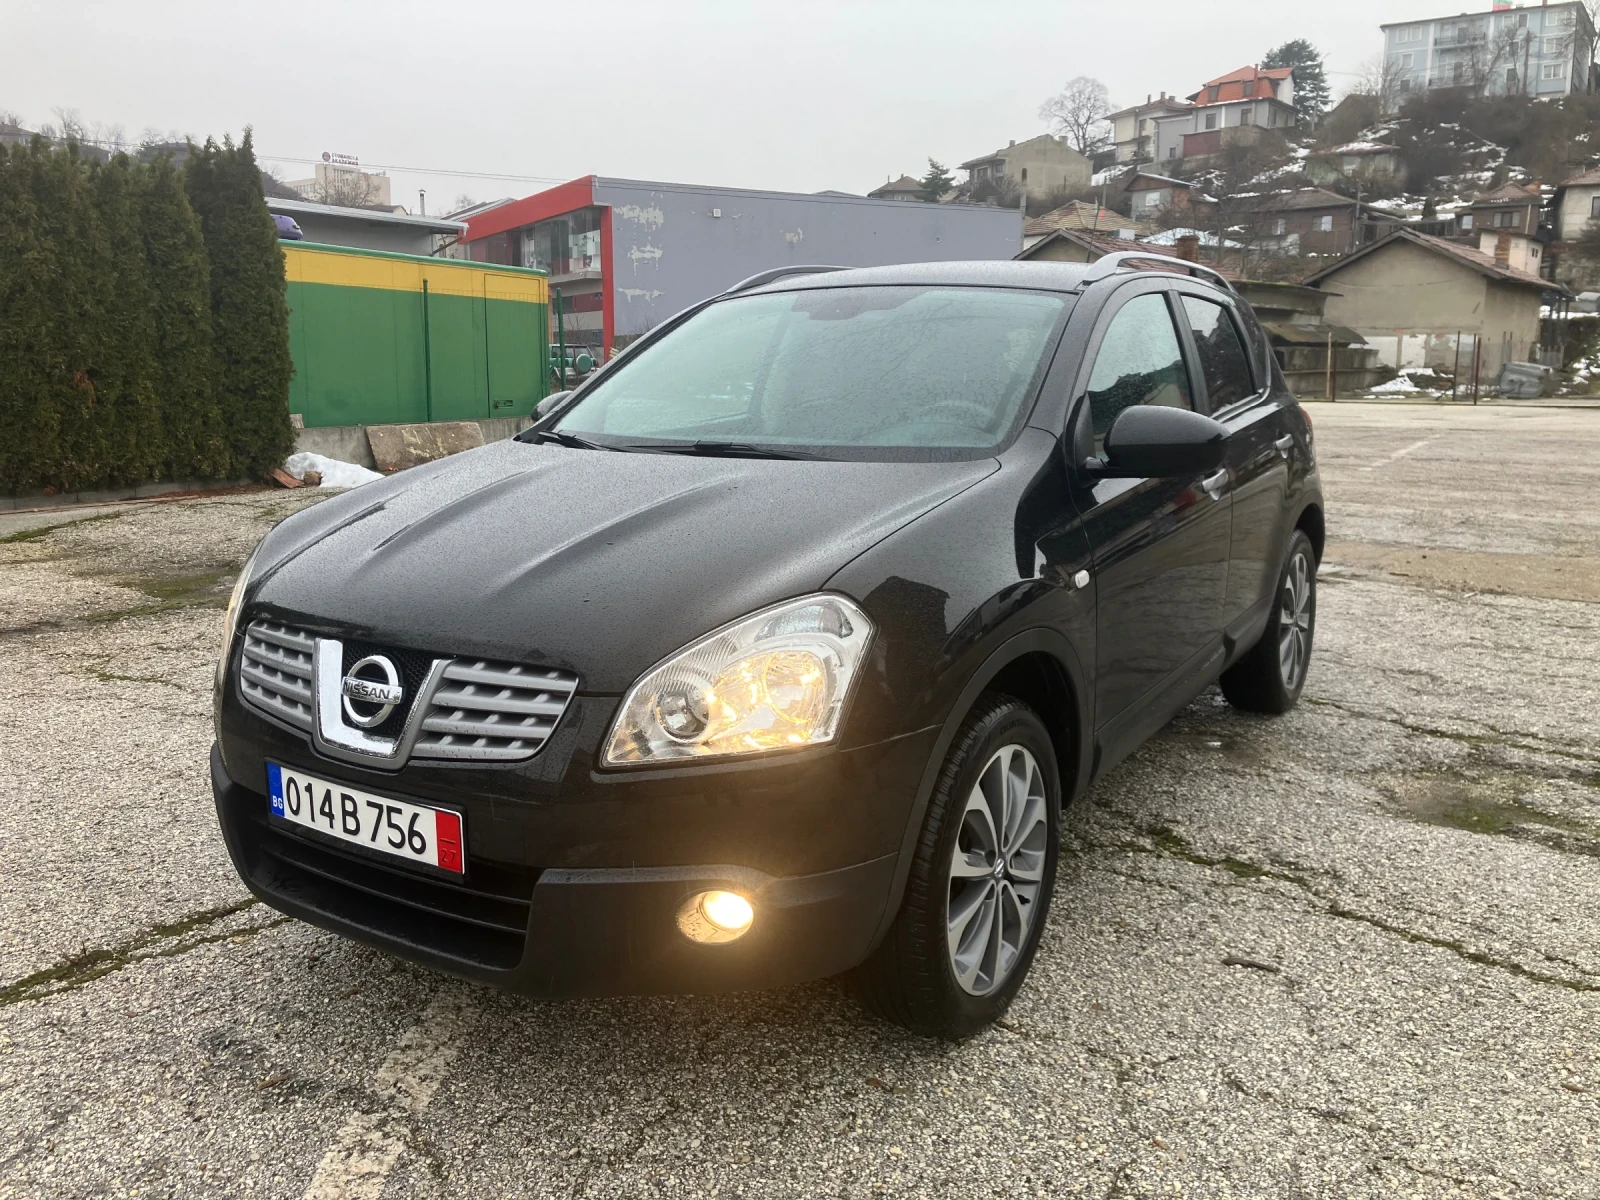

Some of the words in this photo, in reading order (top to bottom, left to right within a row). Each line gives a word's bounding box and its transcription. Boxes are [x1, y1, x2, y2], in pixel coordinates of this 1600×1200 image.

[343, 680, 390, 700] NISSAN
[272, 794, 283, 810] BG
[286, 776, 427, 855] 014B756
[441, 848, 456, 864] 27
